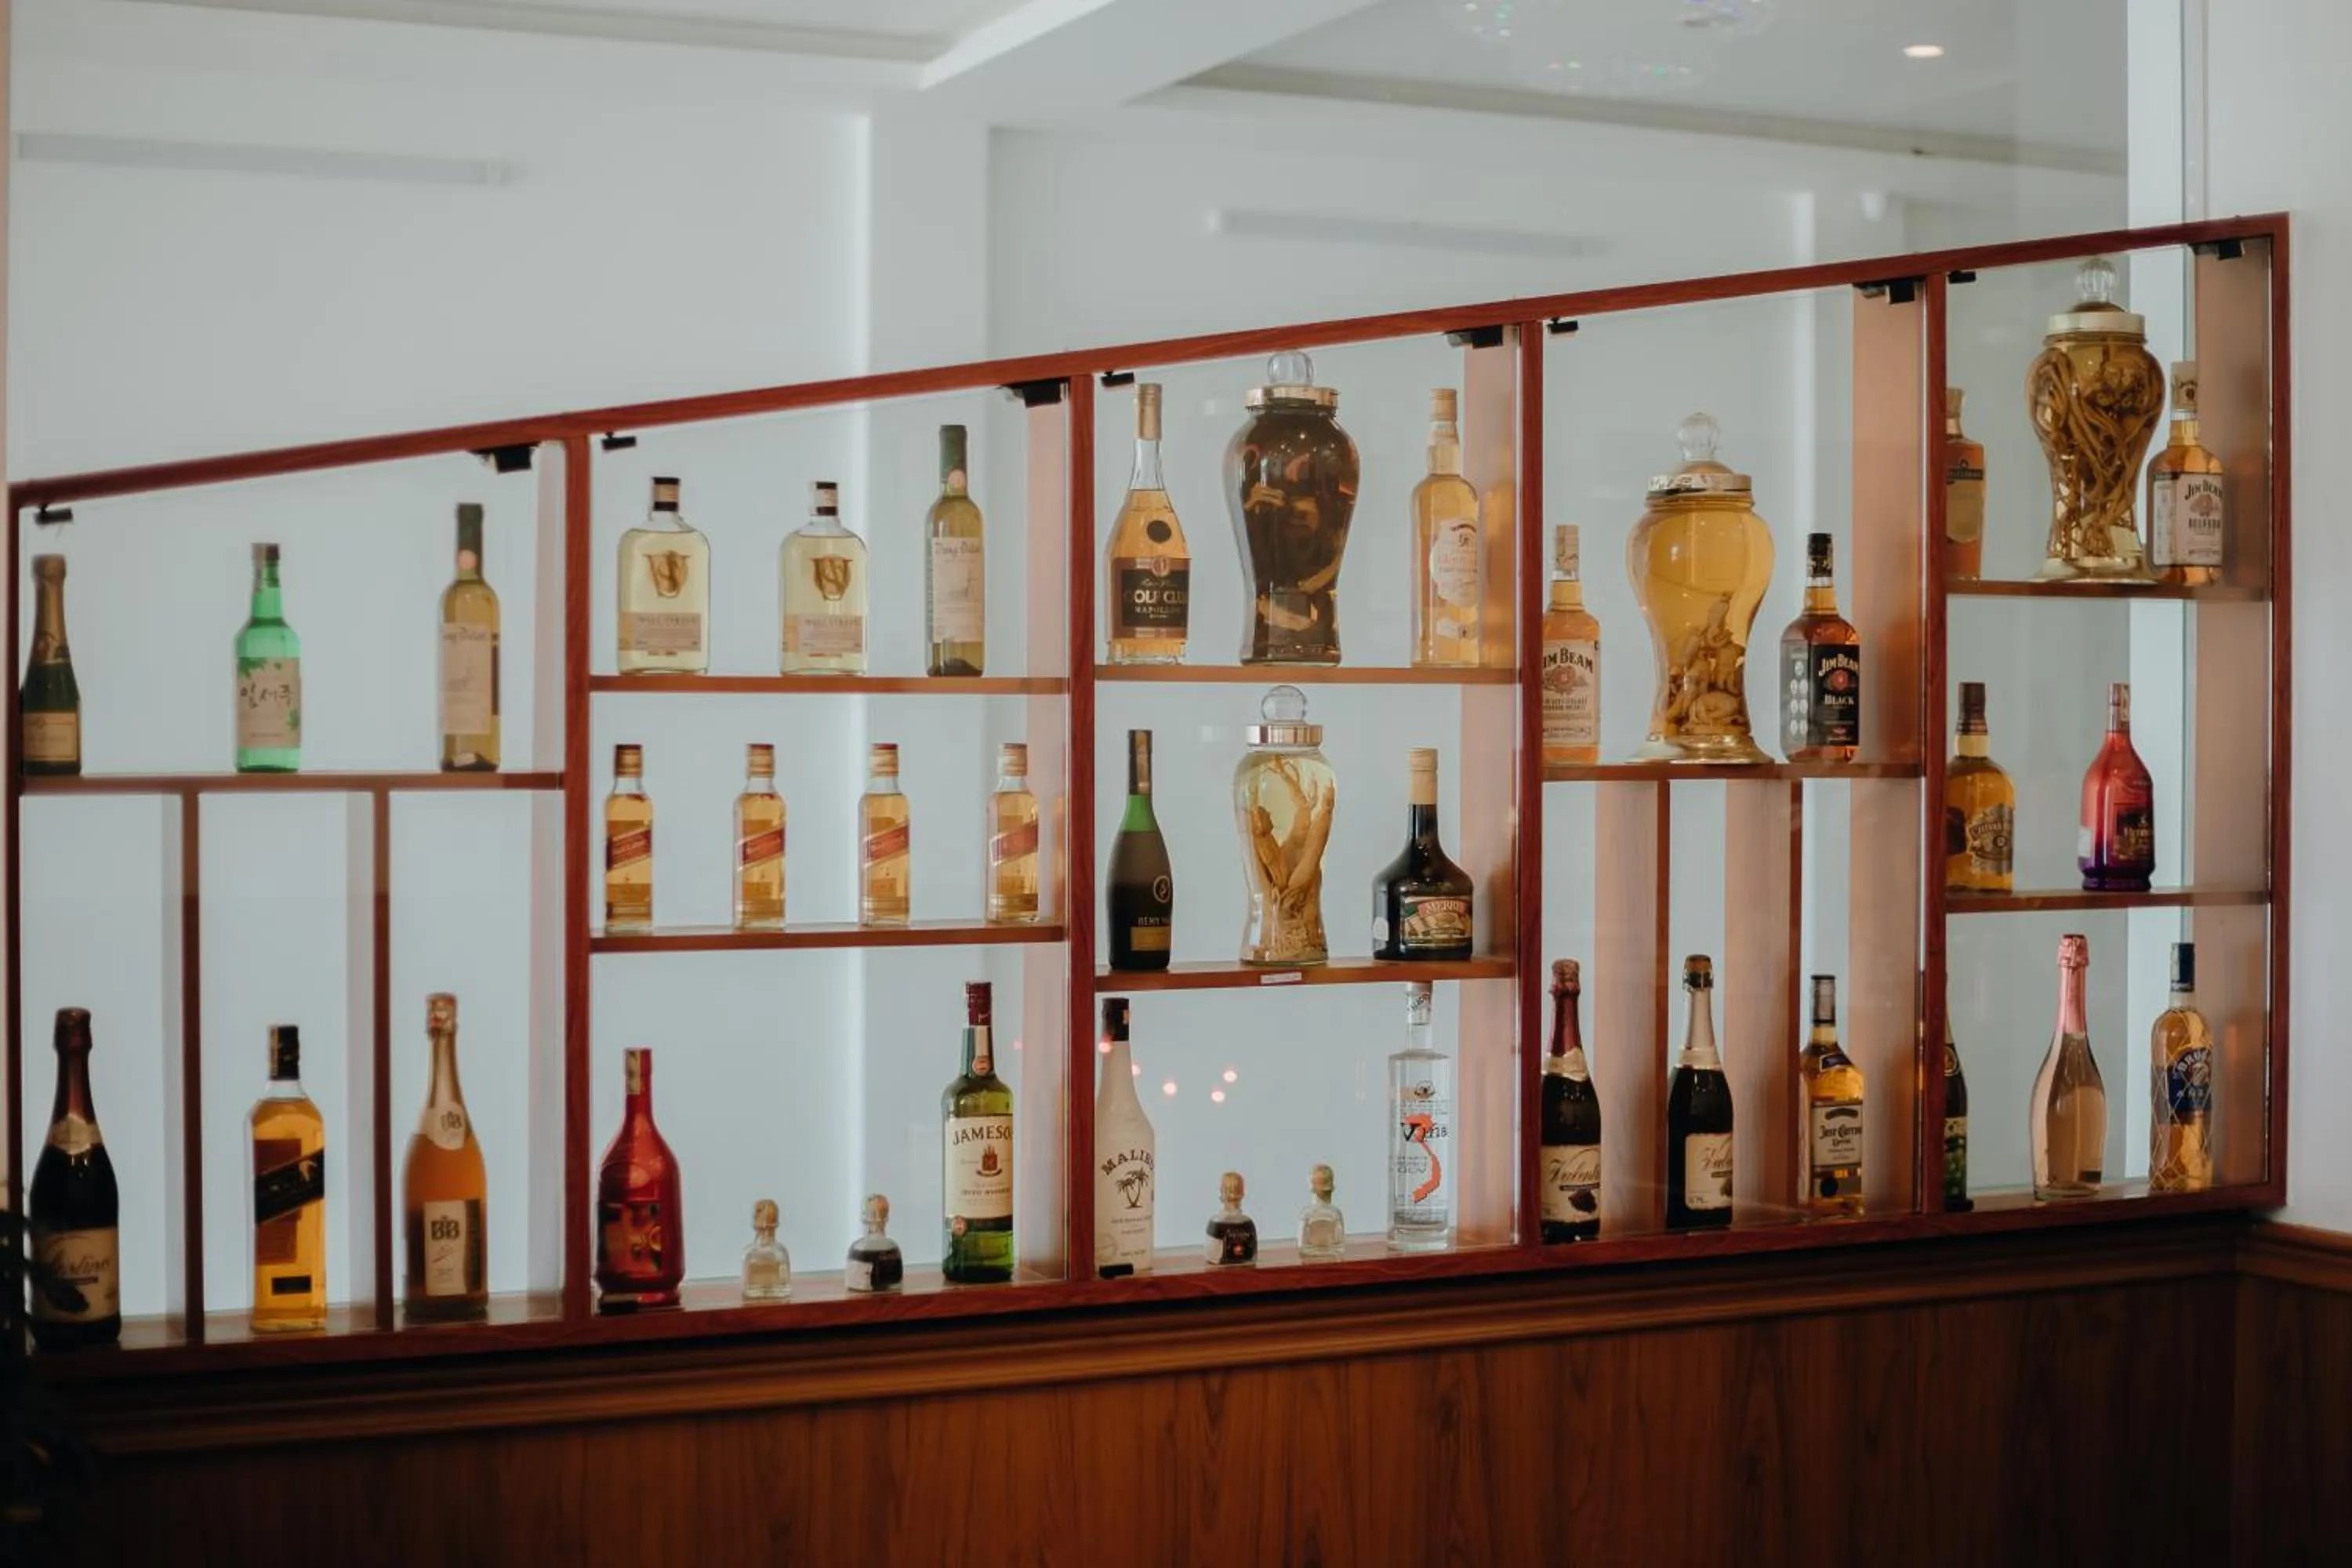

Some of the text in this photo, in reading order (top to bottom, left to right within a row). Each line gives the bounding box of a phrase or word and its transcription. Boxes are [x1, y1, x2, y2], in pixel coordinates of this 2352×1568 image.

[1542, 647, 1593, 673] IM BEAM
[1818, 657, 1837, 677] JIM
